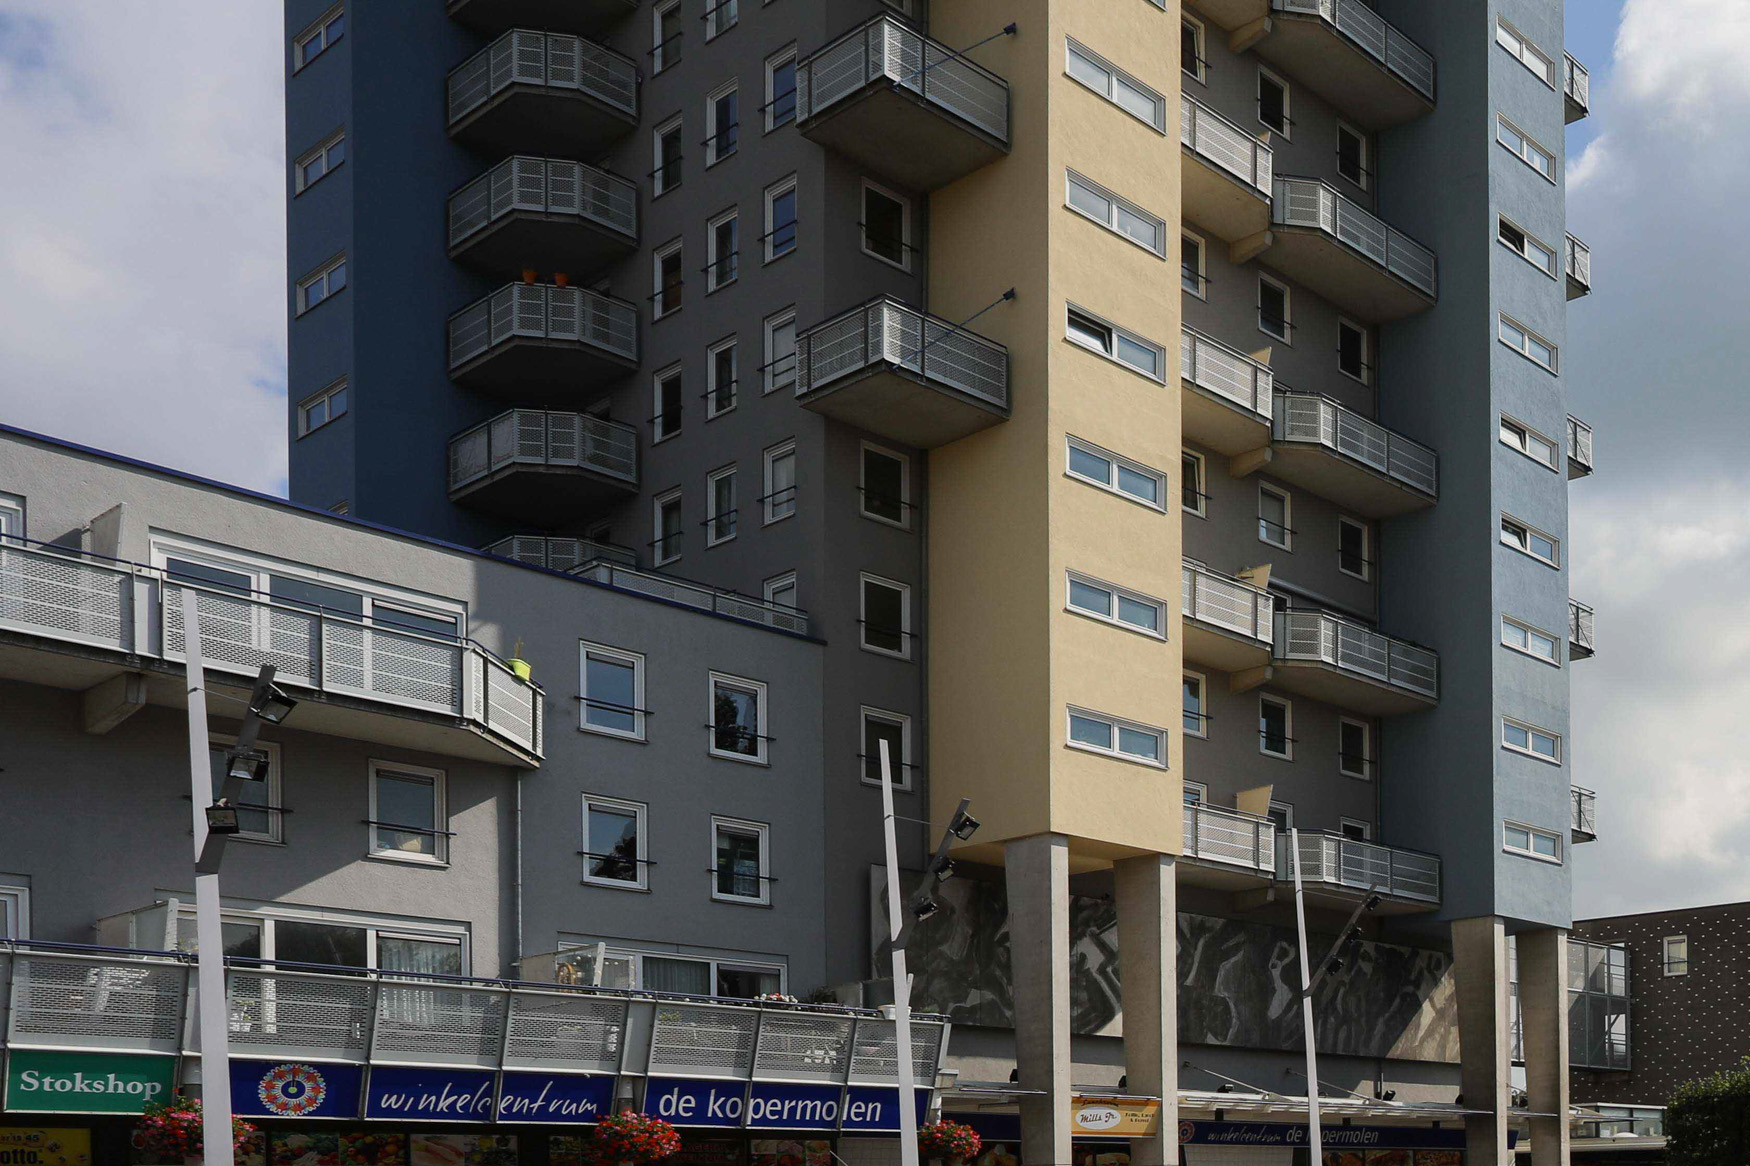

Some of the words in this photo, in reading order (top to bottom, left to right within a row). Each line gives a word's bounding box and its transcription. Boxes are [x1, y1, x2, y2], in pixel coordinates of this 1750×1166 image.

[19, 1069, 163, 1102] Stokshop
[380, 1080, 599, 1117] winkelcentrum
[658, 1086, 697, 1117] de
[706, 1088, 883, 1126] kopermolen
[1207, 1125, 1282, 1143] winkelcentrum
[1286, 1125, 1302, 1143] de
[1305, 1127, 1379, 1145] permolen
